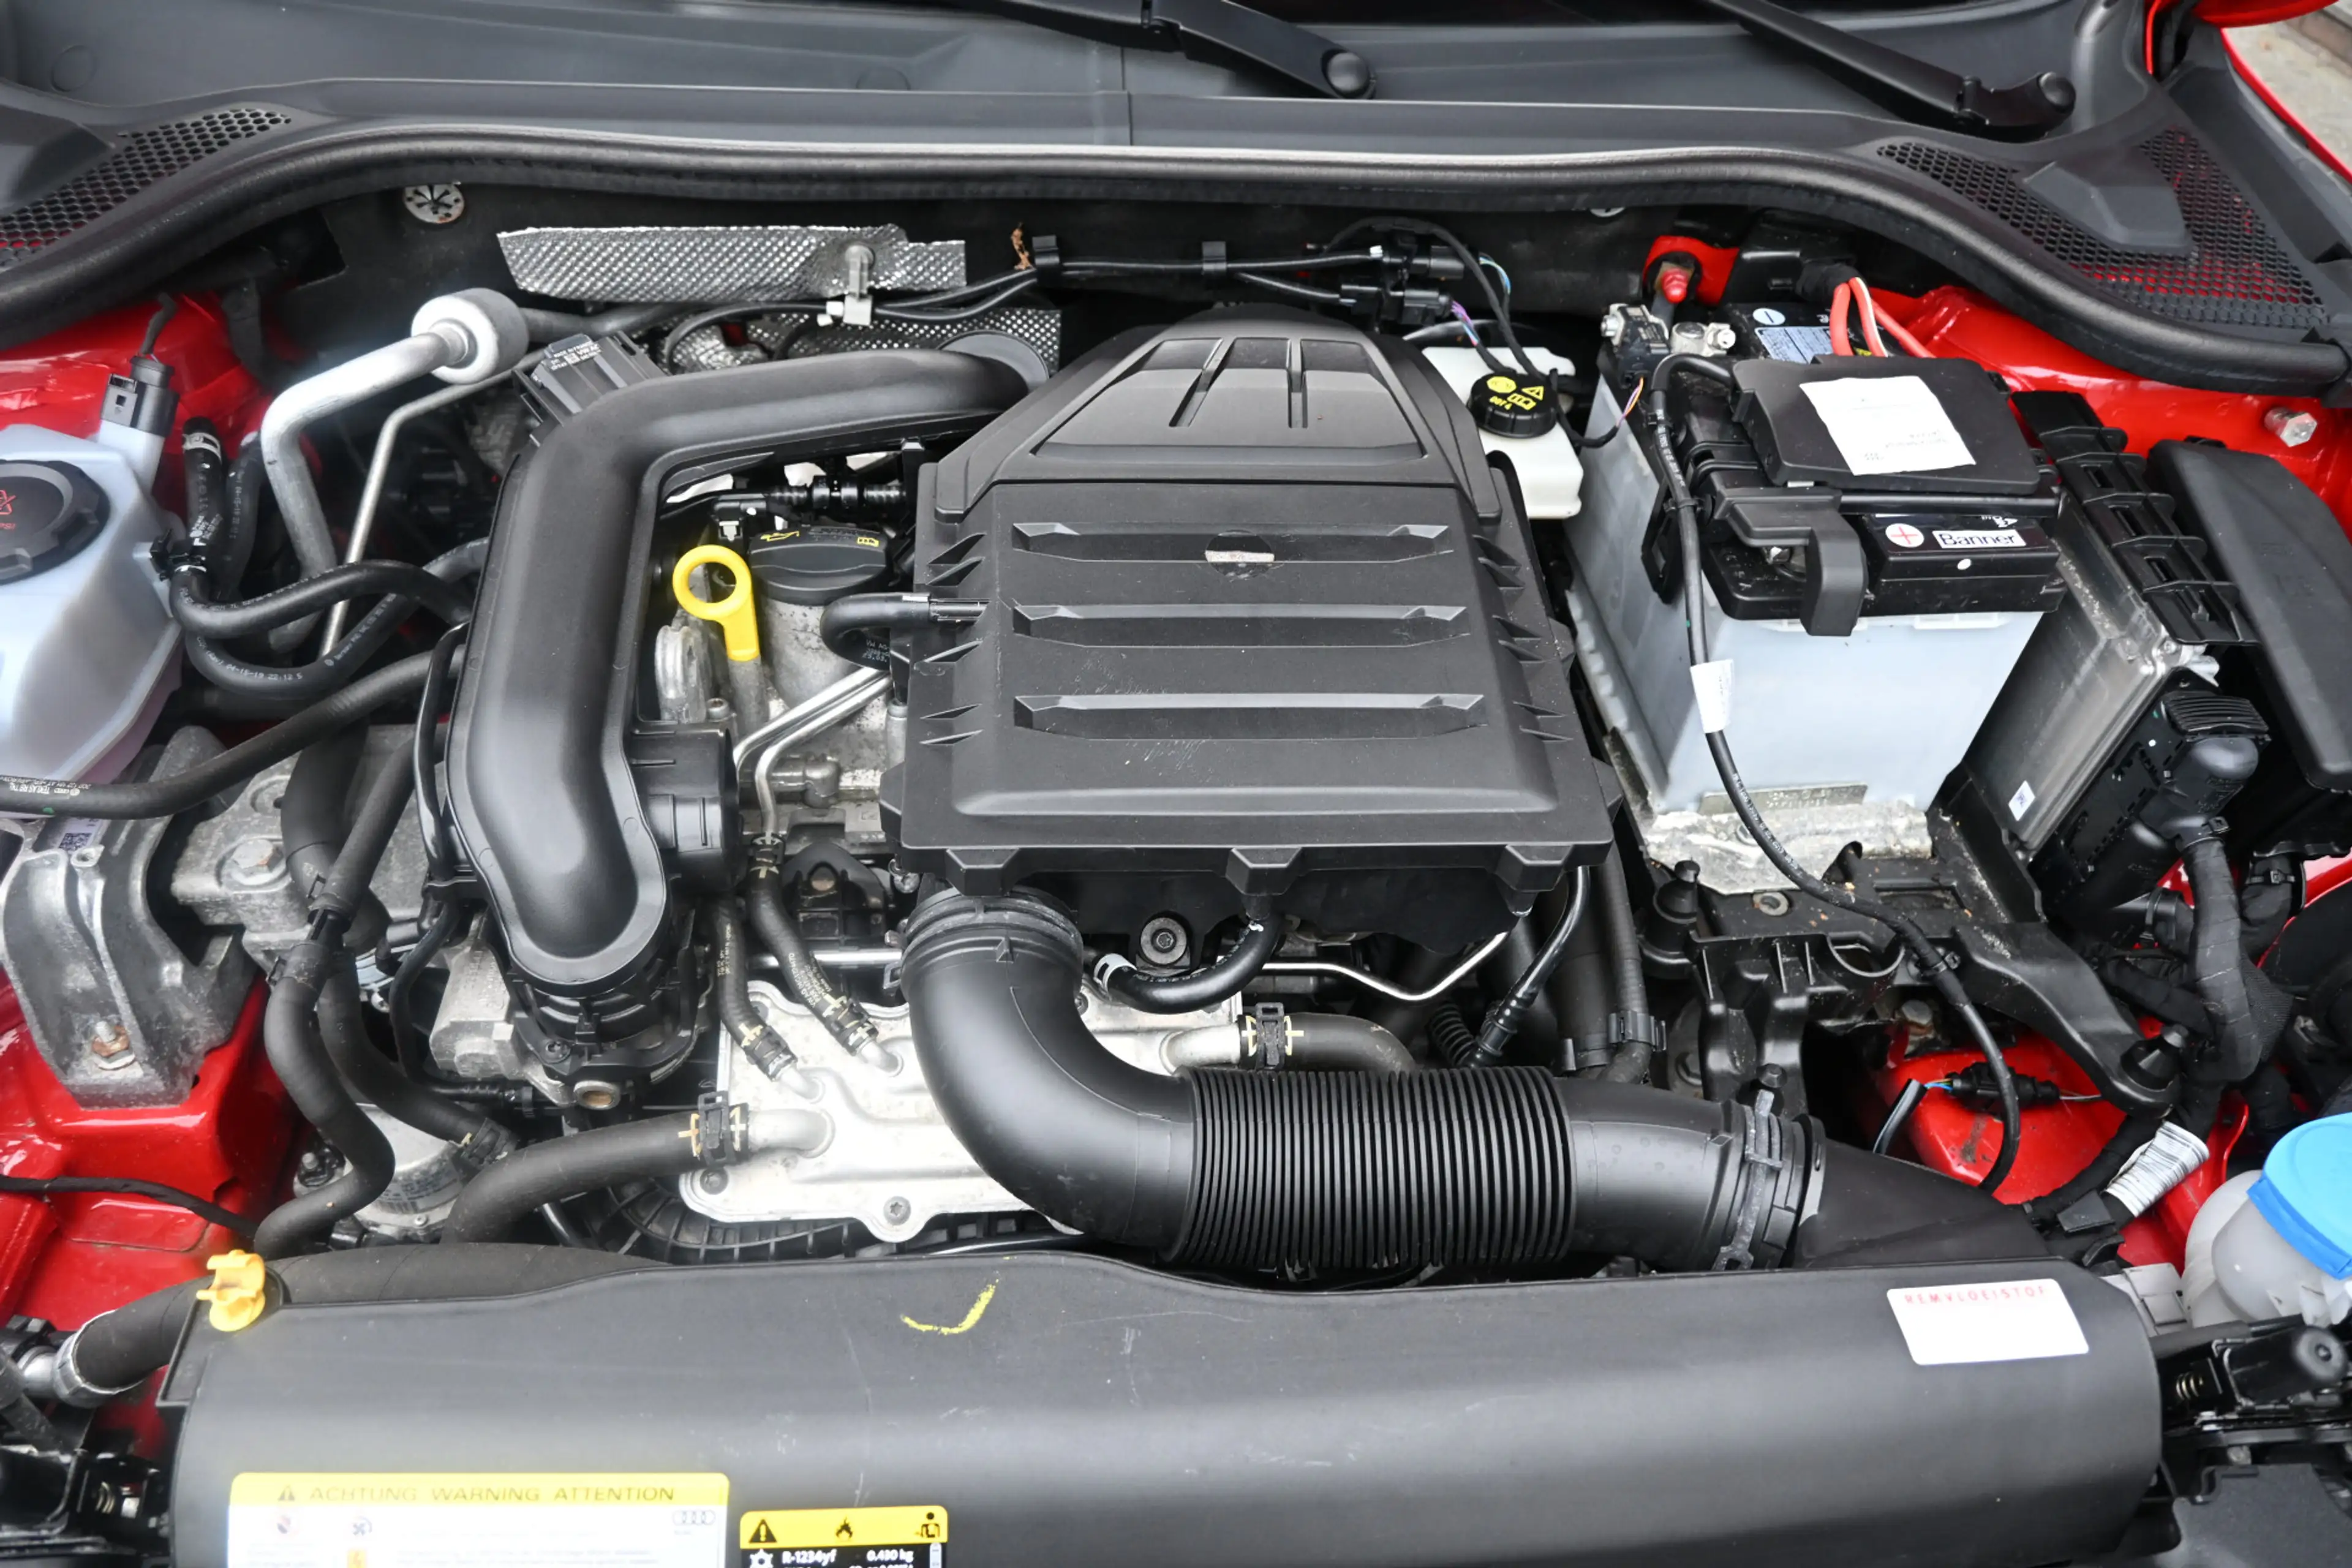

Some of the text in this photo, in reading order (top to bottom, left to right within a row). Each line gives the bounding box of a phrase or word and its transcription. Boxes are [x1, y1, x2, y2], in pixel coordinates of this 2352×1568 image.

[1938, 533, 2015, 546] Banner
[309, 1487, 675, 1501] ACHTUNG WARNING ATTENTION
[782, 1548, 837, 1567] R-1234yf
